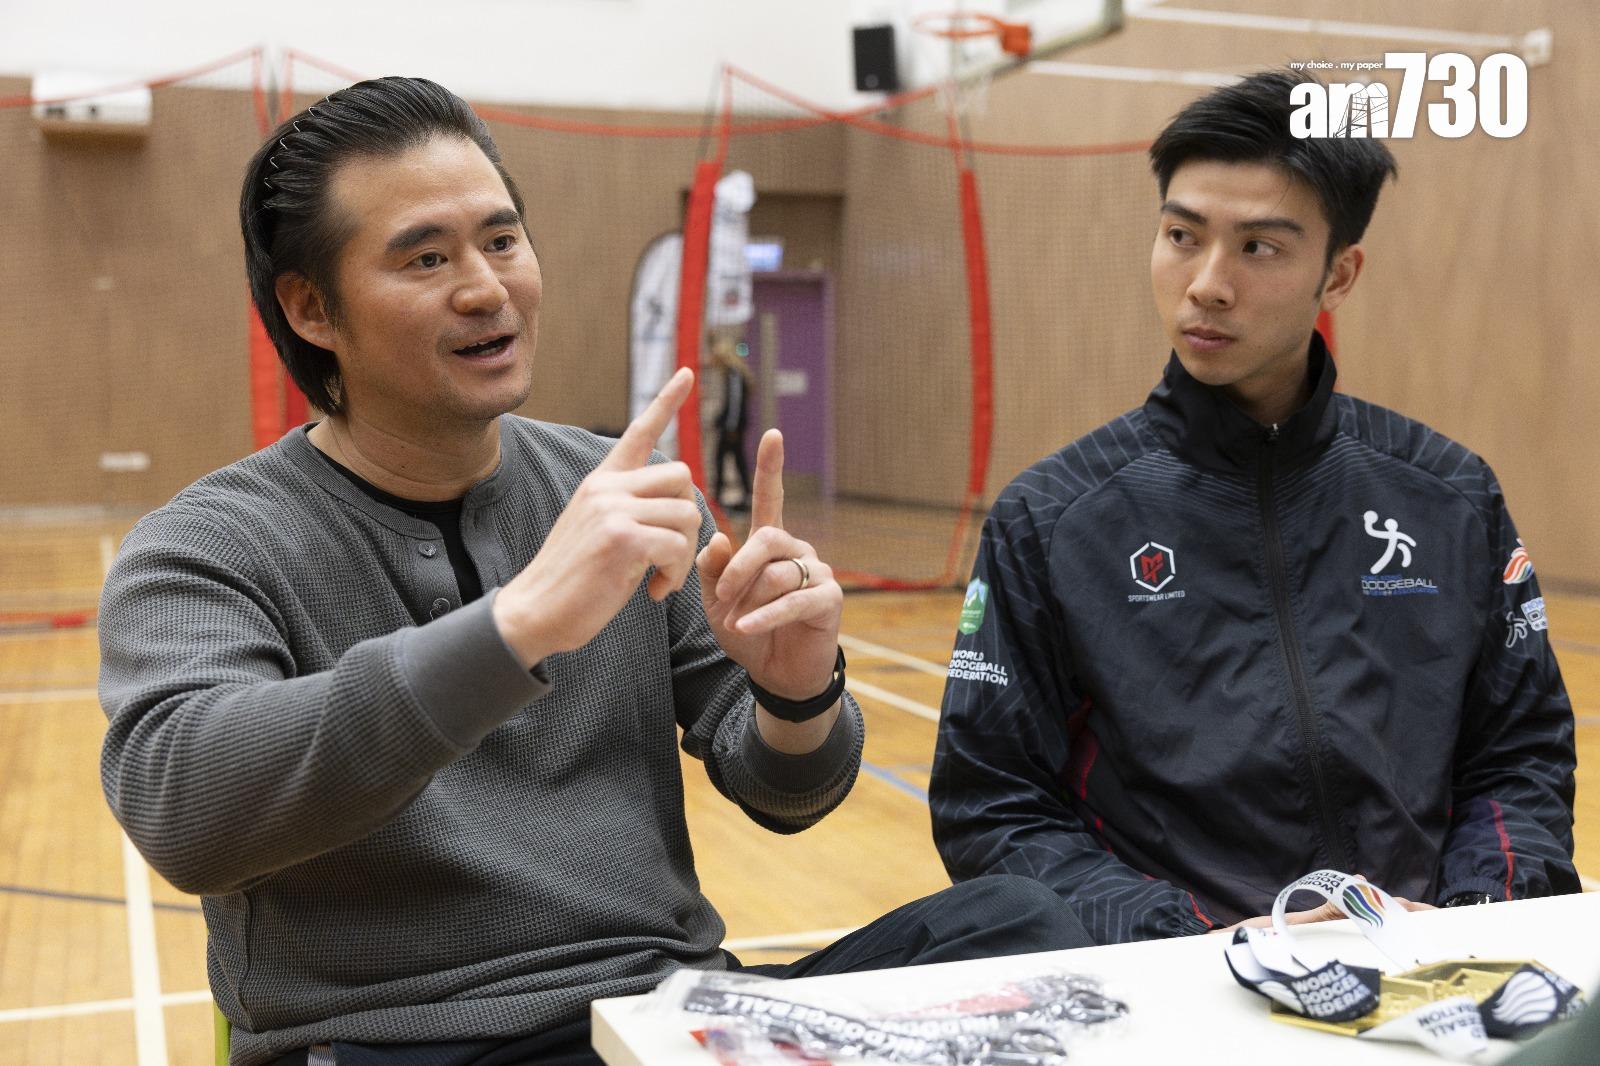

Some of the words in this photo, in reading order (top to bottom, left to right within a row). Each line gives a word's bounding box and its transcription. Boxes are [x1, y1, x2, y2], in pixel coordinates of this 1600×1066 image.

[1361, 578, 1438, 590] DODGEBALL
[1128, 593, 1164, 602] SPORTSWEAR
[1165, 590, 1185, 599] LIMITED
[953, 650, 985, 661] WORLD
[949, 659, 1008, 676] DODGEBALL
[947, 668, 1008, 686] FEDERATION
[1291, 964, 1347, 993] WORLD
